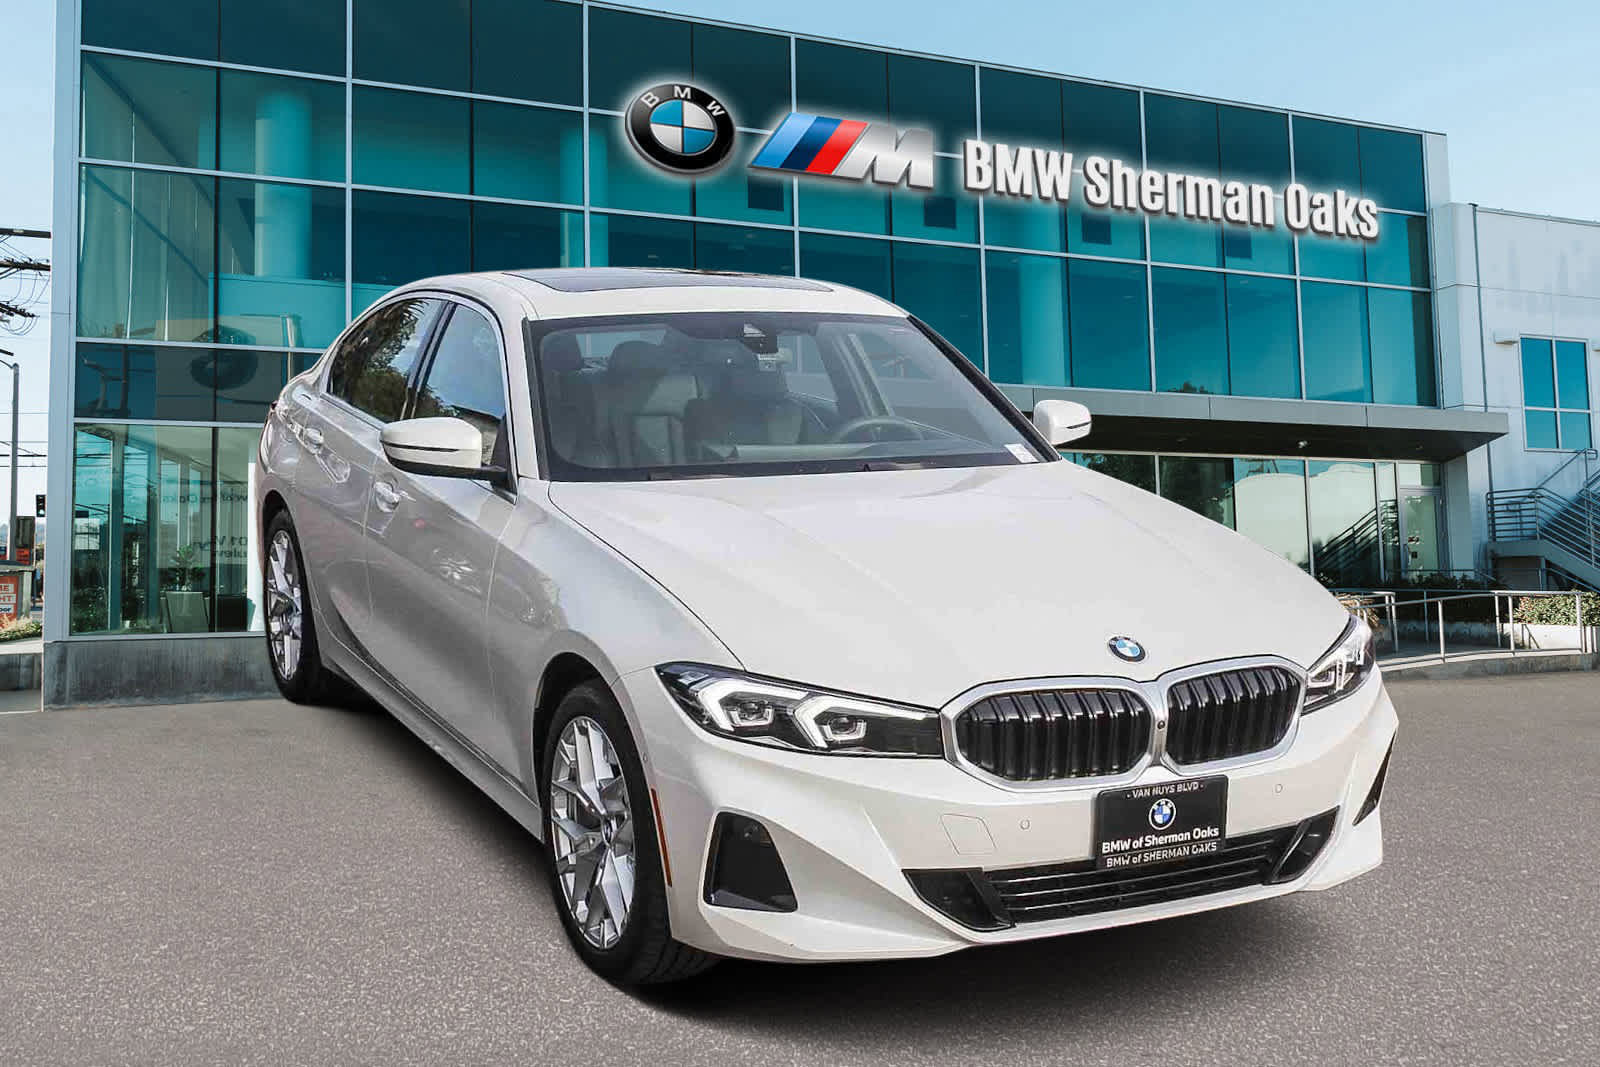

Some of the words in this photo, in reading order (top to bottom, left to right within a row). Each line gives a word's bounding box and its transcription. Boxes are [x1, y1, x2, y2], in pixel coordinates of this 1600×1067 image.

[640, 85, 726, 117] BMW
[963, 139, 1073, 201] BMW
[1083, 156, 1274, 227] Sherman
[1283, 183, 1379, 241] Oaks
[1132, 789, 1150, 798] VAN
[1152, 784, 1175, 795] NUYS
[1176, 781, 1199, 792] BLVD
[1102, 839, 1131, 854] BMW
[1132, 838, 1143, 849] of
[1144, 832, 1190, 846] Sherman
[1192, 827, 1219, 839] Oaks
[1106, 854, 1132, 868] BMW
[1133, 854, 1142, 864] of
[1143, 846, 1190, 862] SHERMAN
[1191, 841, 1217, 855] OAKS
